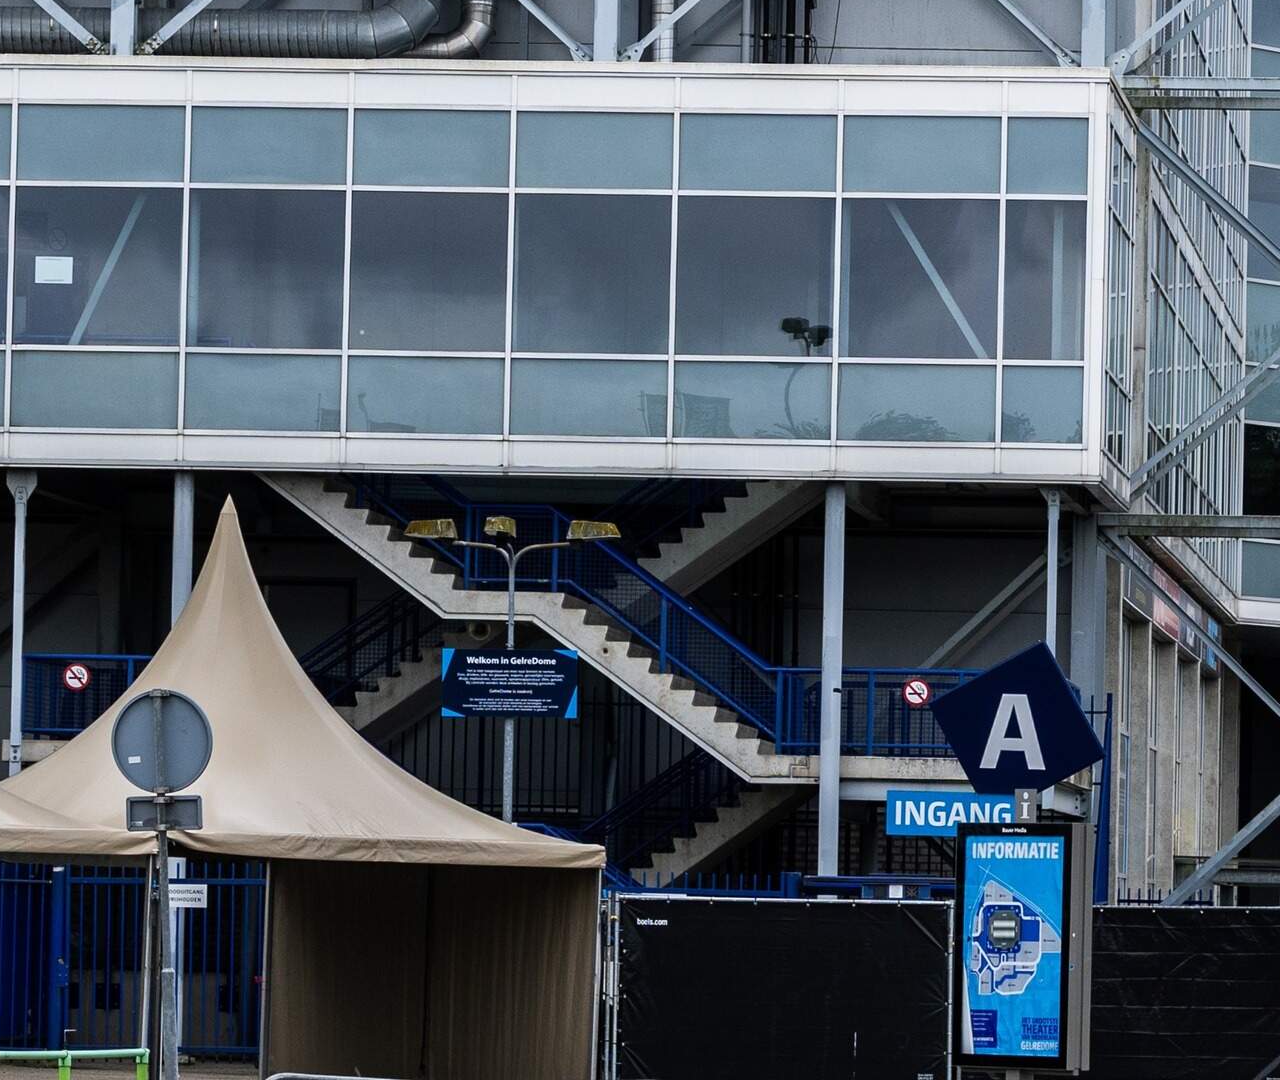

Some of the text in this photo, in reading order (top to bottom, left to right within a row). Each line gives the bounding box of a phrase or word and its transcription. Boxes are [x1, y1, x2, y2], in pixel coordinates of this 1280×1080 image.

[466, 656, 557, 665] Welkom in GelreDome
[979, 693, 1046, 771] A
[895, 800, 1012, 827] INGANG
[972, 842, 1059, 859] INFORMATIE
[636, 918, 668, 926] boels.com
[1022, 1024, 1057, 1034] THEATER
